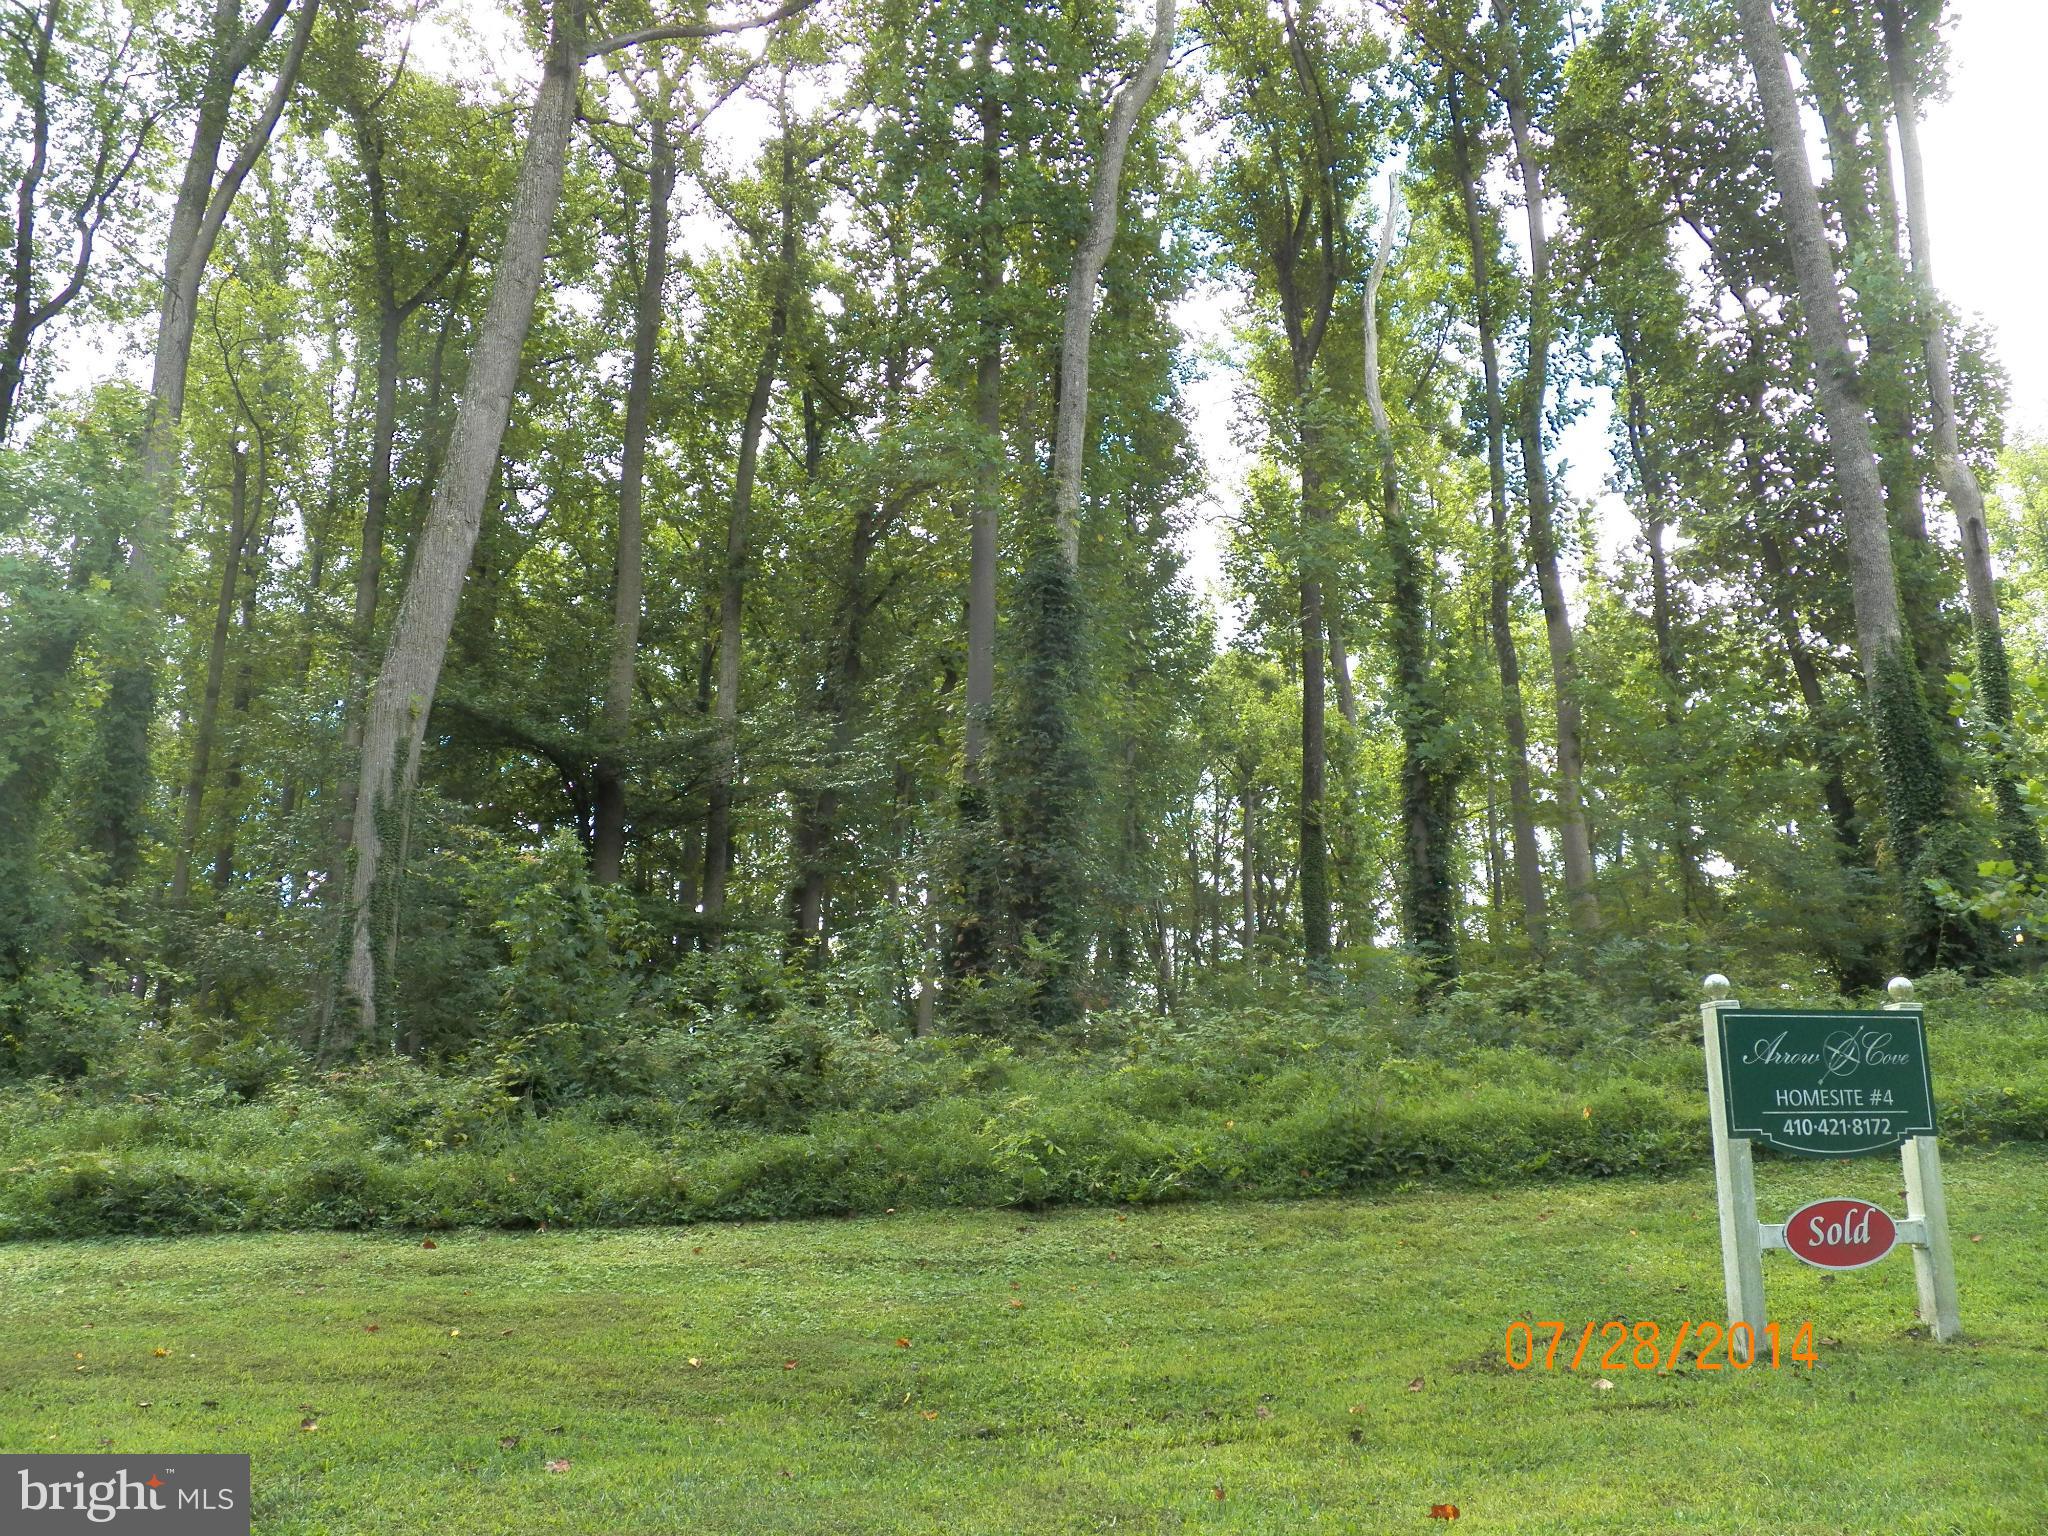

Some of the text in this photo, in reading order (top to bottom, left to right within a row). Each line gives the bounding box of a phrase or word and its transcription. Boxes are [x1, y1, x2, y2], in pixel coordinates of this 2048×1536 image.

[1742, 1030, 1911, 1067] Arrow Cove
[1775, 1088, 1894, 1107] HOMESITE #4
[1808, 1207, 1876, 1248] Sold
